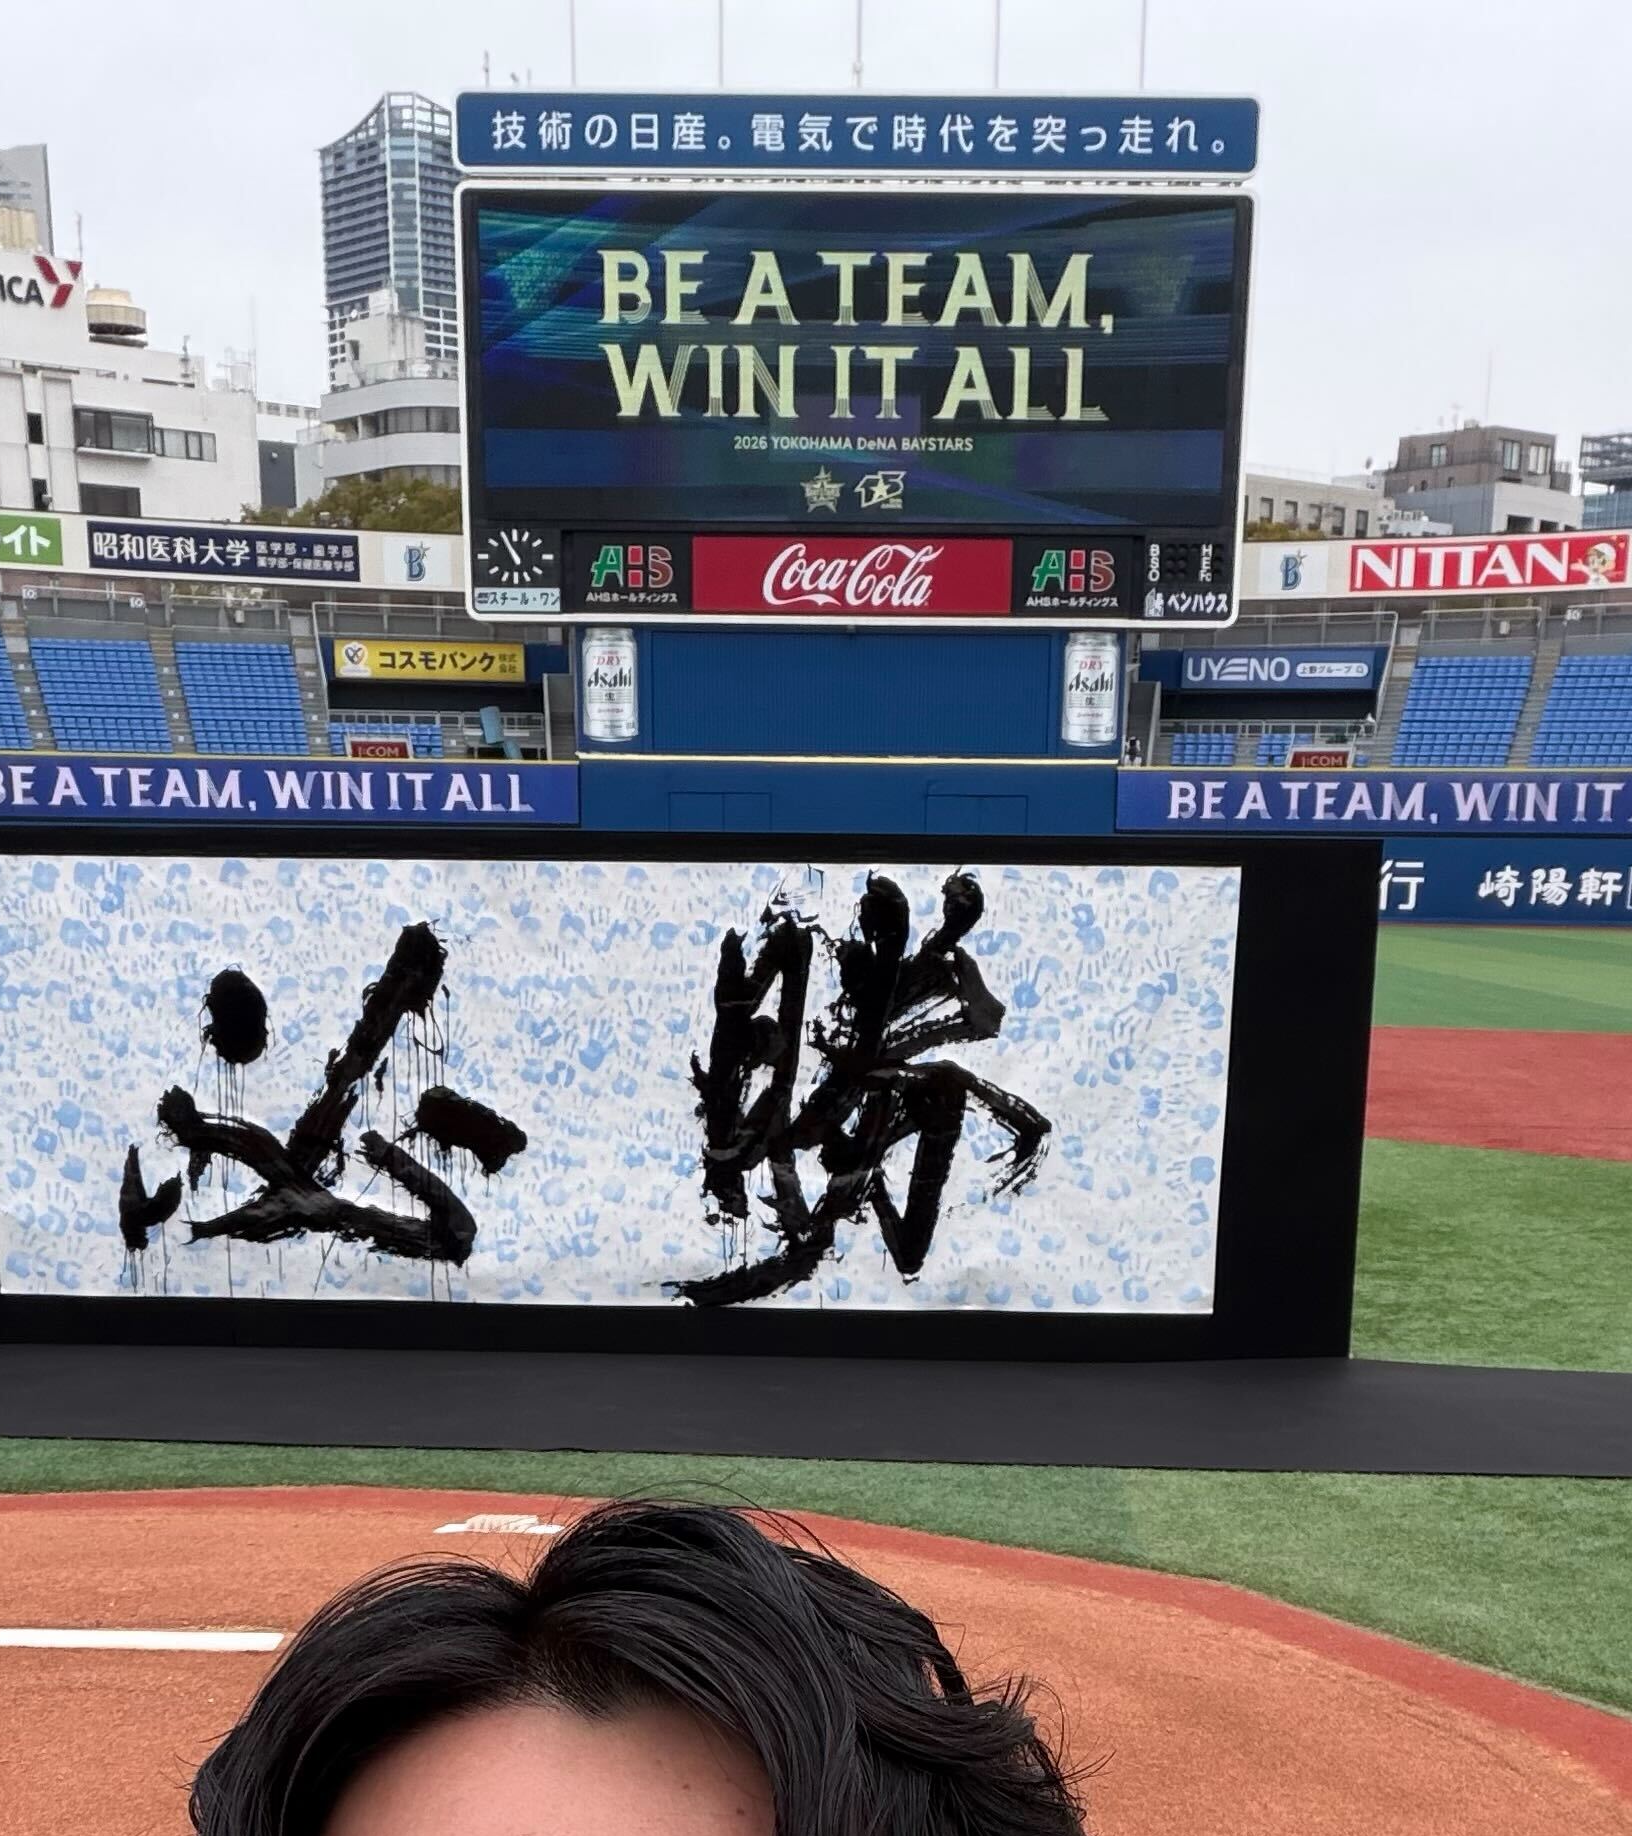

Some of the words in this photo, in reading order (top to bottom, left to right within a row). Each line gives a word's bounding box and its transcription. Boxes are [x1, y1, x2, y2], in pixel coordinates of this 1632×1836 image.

[490, 110, 1227, 155] 技術の日産。電気で時代を突っ走れ。
[598, 249, 709, 326] BE
[730, 250, 802, 327] A
[817, 251, 1115, 335] TEAM,
[599, 343, 799, 420] WIN
[831, 344, 920, 421] IT
[934, 345, 1110, 423] ALL
[733, 435, 768, 451] 2026
[771, 436, 853, 451] YOKOHAMA
[856, 437, 898, 452] DeNA
[900, 437, 975, 452] BAYSTARS
[92, 531, 251, 568] 昭和医科大学
[1353, 540, 1568, 591] NITTAN
[762, 543, 945, 608] Coca-Cola
[378, 650, 497, 674] コスモバンク
[587, 666, 633, 688] Asahi
[1068, 671, 1115, 692] Asahi
[1186, 656, 1291, 683] UYENO
[49, 767, 86, 805] A
[91, 767, 256, 811] TEAM,
[265, 771, 374, 809] WIN
[387, 773, 433, 810] IT
[442, 774, 532, 811] ALL
[1168, 781, 1226, 818] BE
[1235, 782, 1270, 819] A
[1280, 782, 1437, 823] TEAM,
[1450, 783, 1560, 821] WIN
[1575, 783, 1624, 821] IT
[1478, 864, 1624, 907] 崎陽軒
[120, 866, 1051, 1308] 必勝
